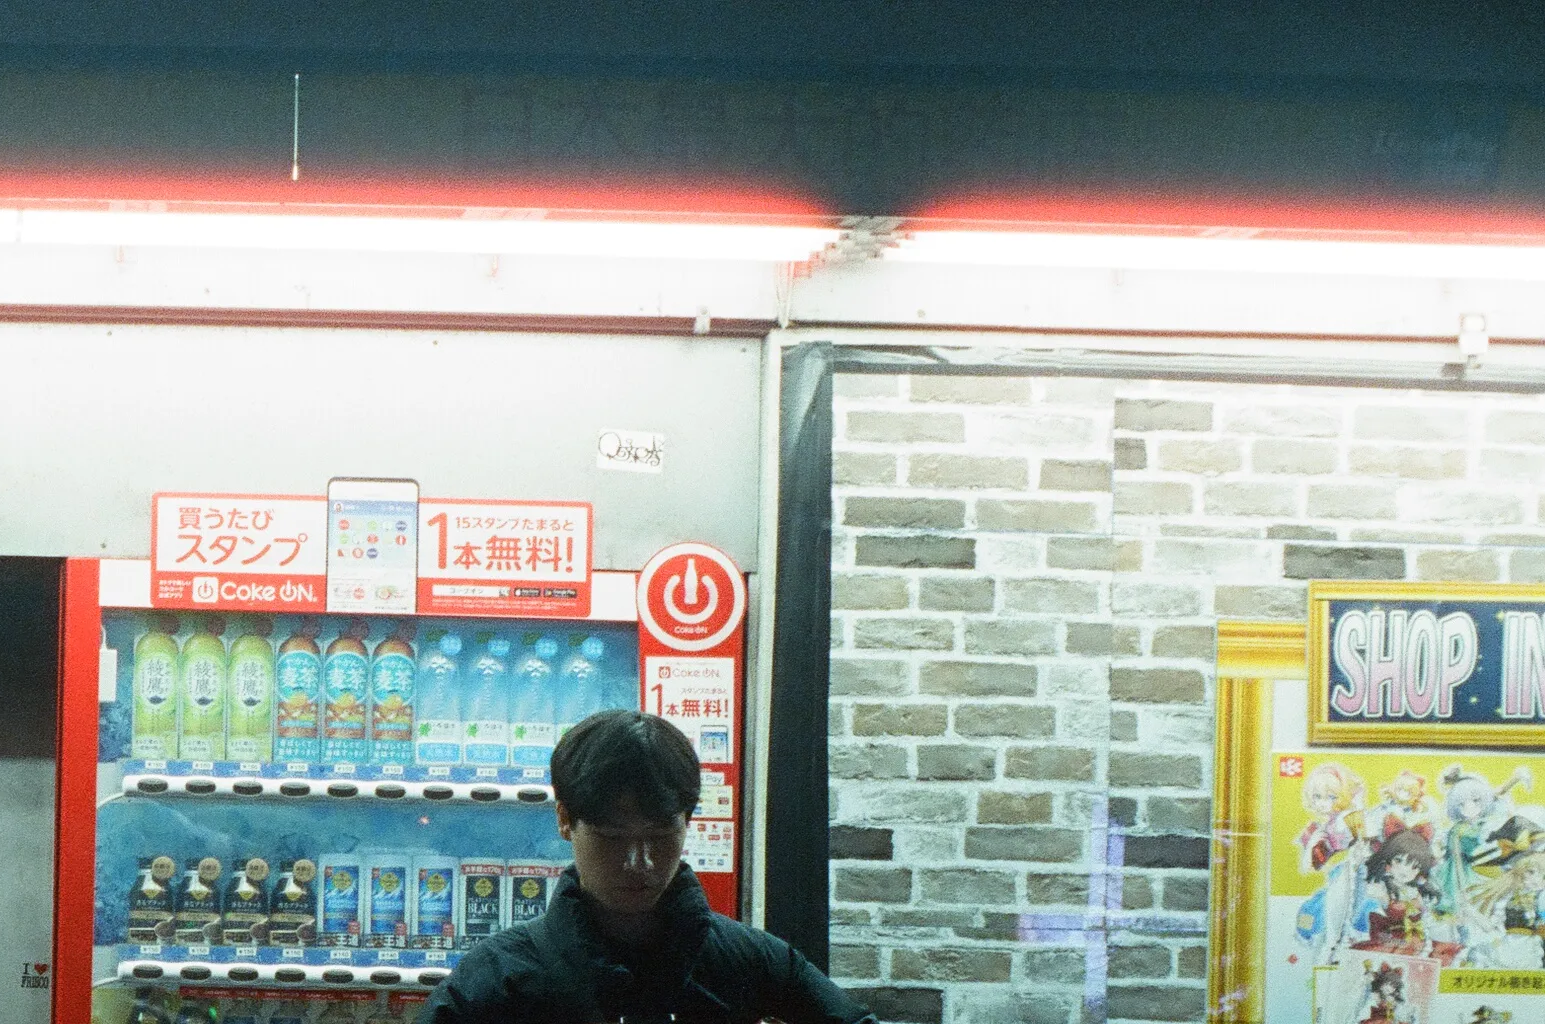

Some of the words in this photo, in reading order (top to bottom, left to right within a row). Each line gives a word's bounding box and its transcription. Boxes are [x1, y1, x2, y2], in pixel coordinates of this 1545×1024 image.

[179, 507, 274, 530] 買うたび
[455, 516, 574, 531] 15スタンプたまると
[176, 533, 308, 566] スタンプ
[220, 582, 275, 602] Coke
[672, 668, 700, 678] Coke
[1332, 609, 1478, 718] SHOP
[146, 661, 166, 697] 綾鷹
[194, 661, 215, 697] 綾鷹
[240, 662, 259, 697] 綾鷹
[706, 775, 722, 784] Pay
[467, 902, 499, 913] BLACK
[514, 904, 545, 915] BLACK
[22, 962, 30, 974] I
